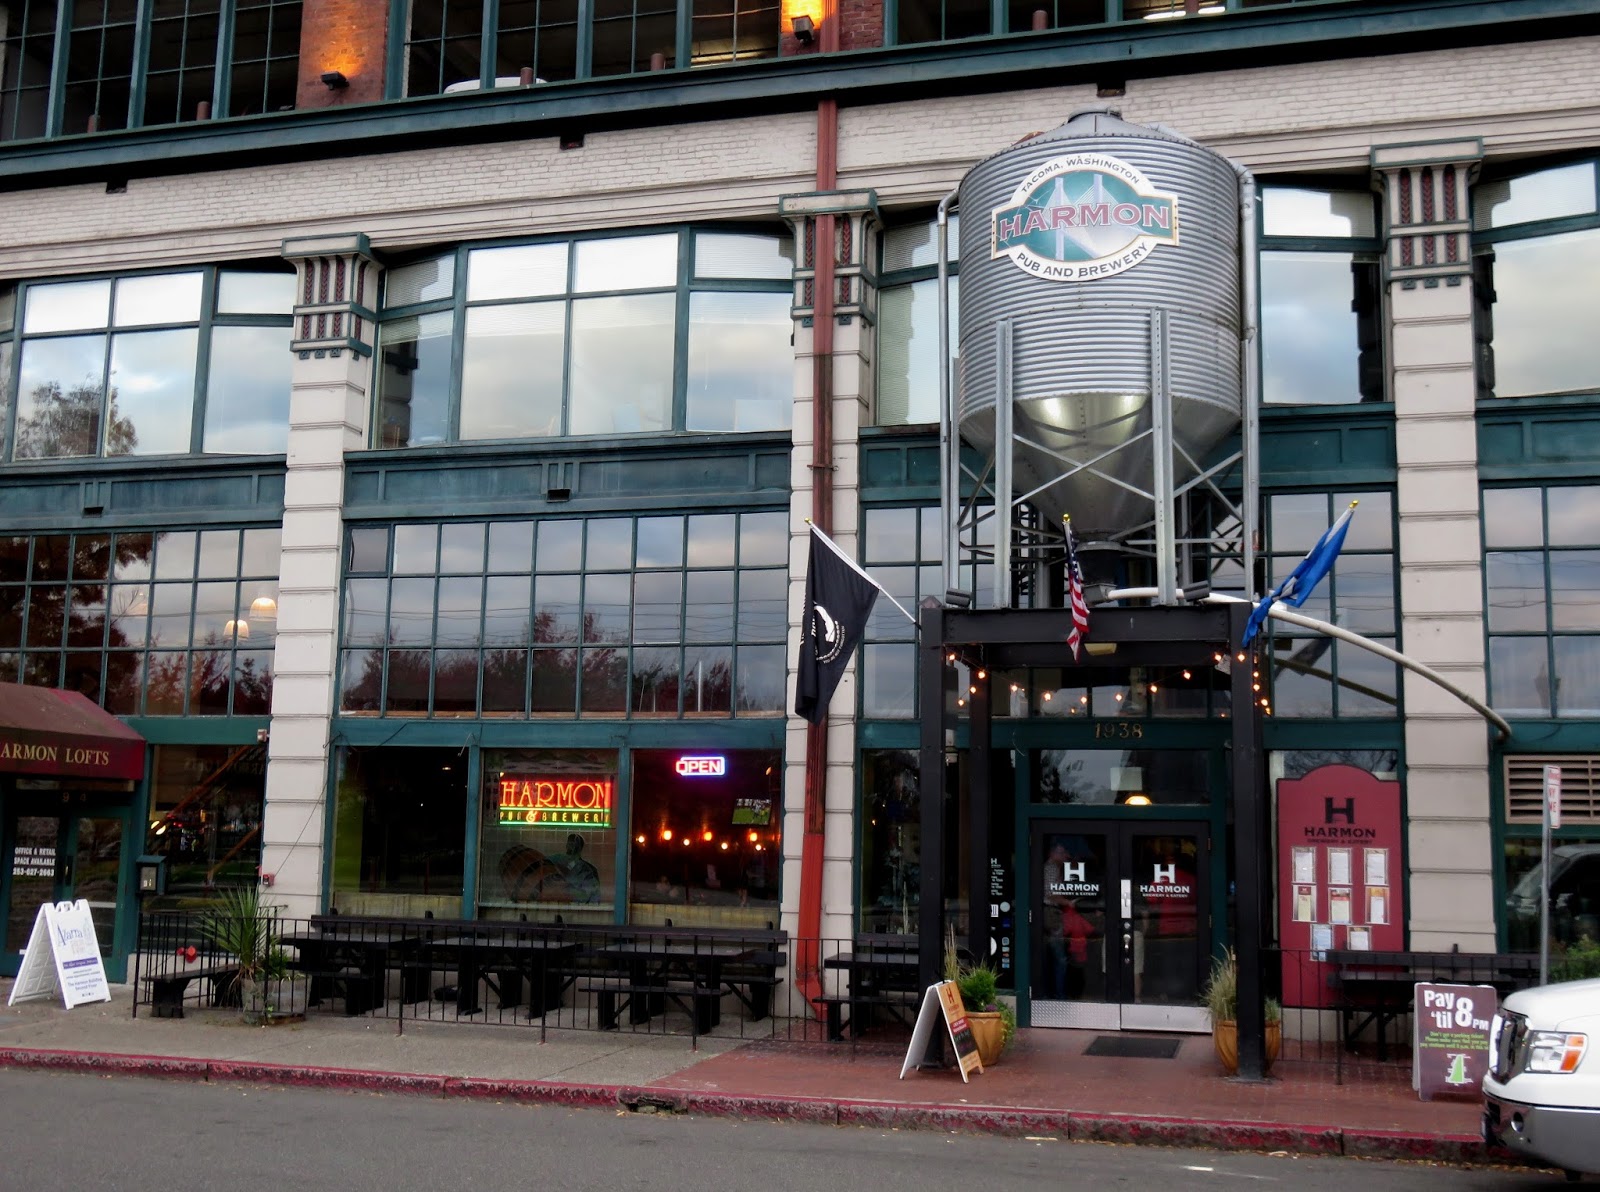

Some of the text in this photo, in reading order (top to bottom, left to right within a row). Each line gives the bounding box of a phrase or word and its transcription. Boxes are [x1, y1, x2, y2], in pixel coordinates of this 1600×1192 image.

[1021, 157, 1140, 192] TACOMA, WASHINGTON
[1000, 202, 1168, 242] HARMON
[1016, 242, 1148, 278] PUB AND BREWERY
[1094, 722, 1143, 738] 1938
[1, 743, 110, 766] ARMON LOFTS
[676, 760, 722, 774] OPEN
[500, 781, 612, 808] HARMON
[526, 810, 538, 823] &
[542, 812, 610, 823] BREWERY
[1304, 826, 1376, 838] HARMON
[14, 857, 56, 866] SPACE AVAILABLE
[1063, 862, 1085, 882] H
[1154, 864, 1175, 884] H
[1050, 883, 1099, 892] HARMON
[1140, 885, 1190, 894] HARMON
[1424, 990, 1455, 1009] Pay
[1455, 997, 1474, 1027] 8
[1473, 1019, 1489, 1030] PM
